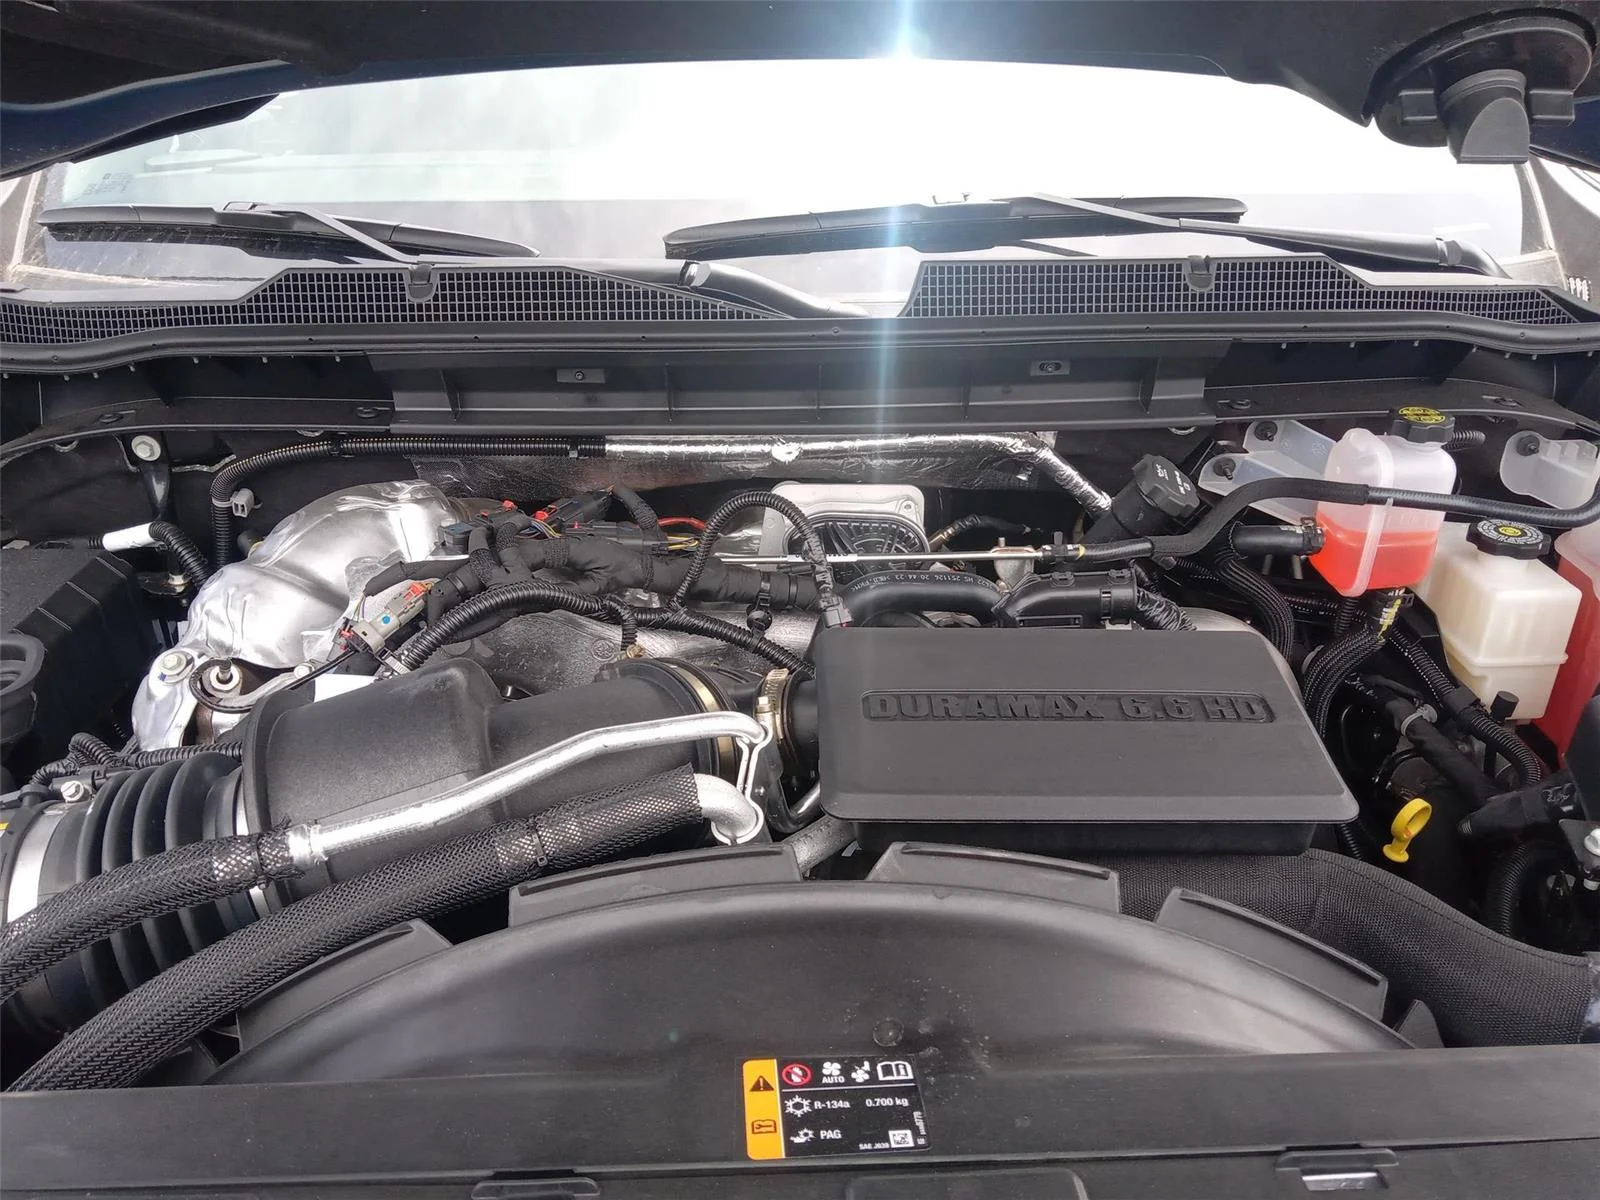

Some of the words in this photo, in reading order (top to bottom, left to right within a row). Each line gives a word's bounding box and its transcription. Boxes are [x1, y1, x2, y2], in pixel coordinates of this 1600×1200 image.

[869, 693, 1104, 719] DURAMAX
[1119, 695, 1194, 720] 6.6
[1201, 694, 1276, 722] HD
[822, 1076, 845, 1084] AUTO
[814, 1101, 851, 1109] R-134a
[866, 1098, 893, 1107] 0.700
[895, 1097, 909, 1107] kg
[820, 1130, 842, 1139] PAG
